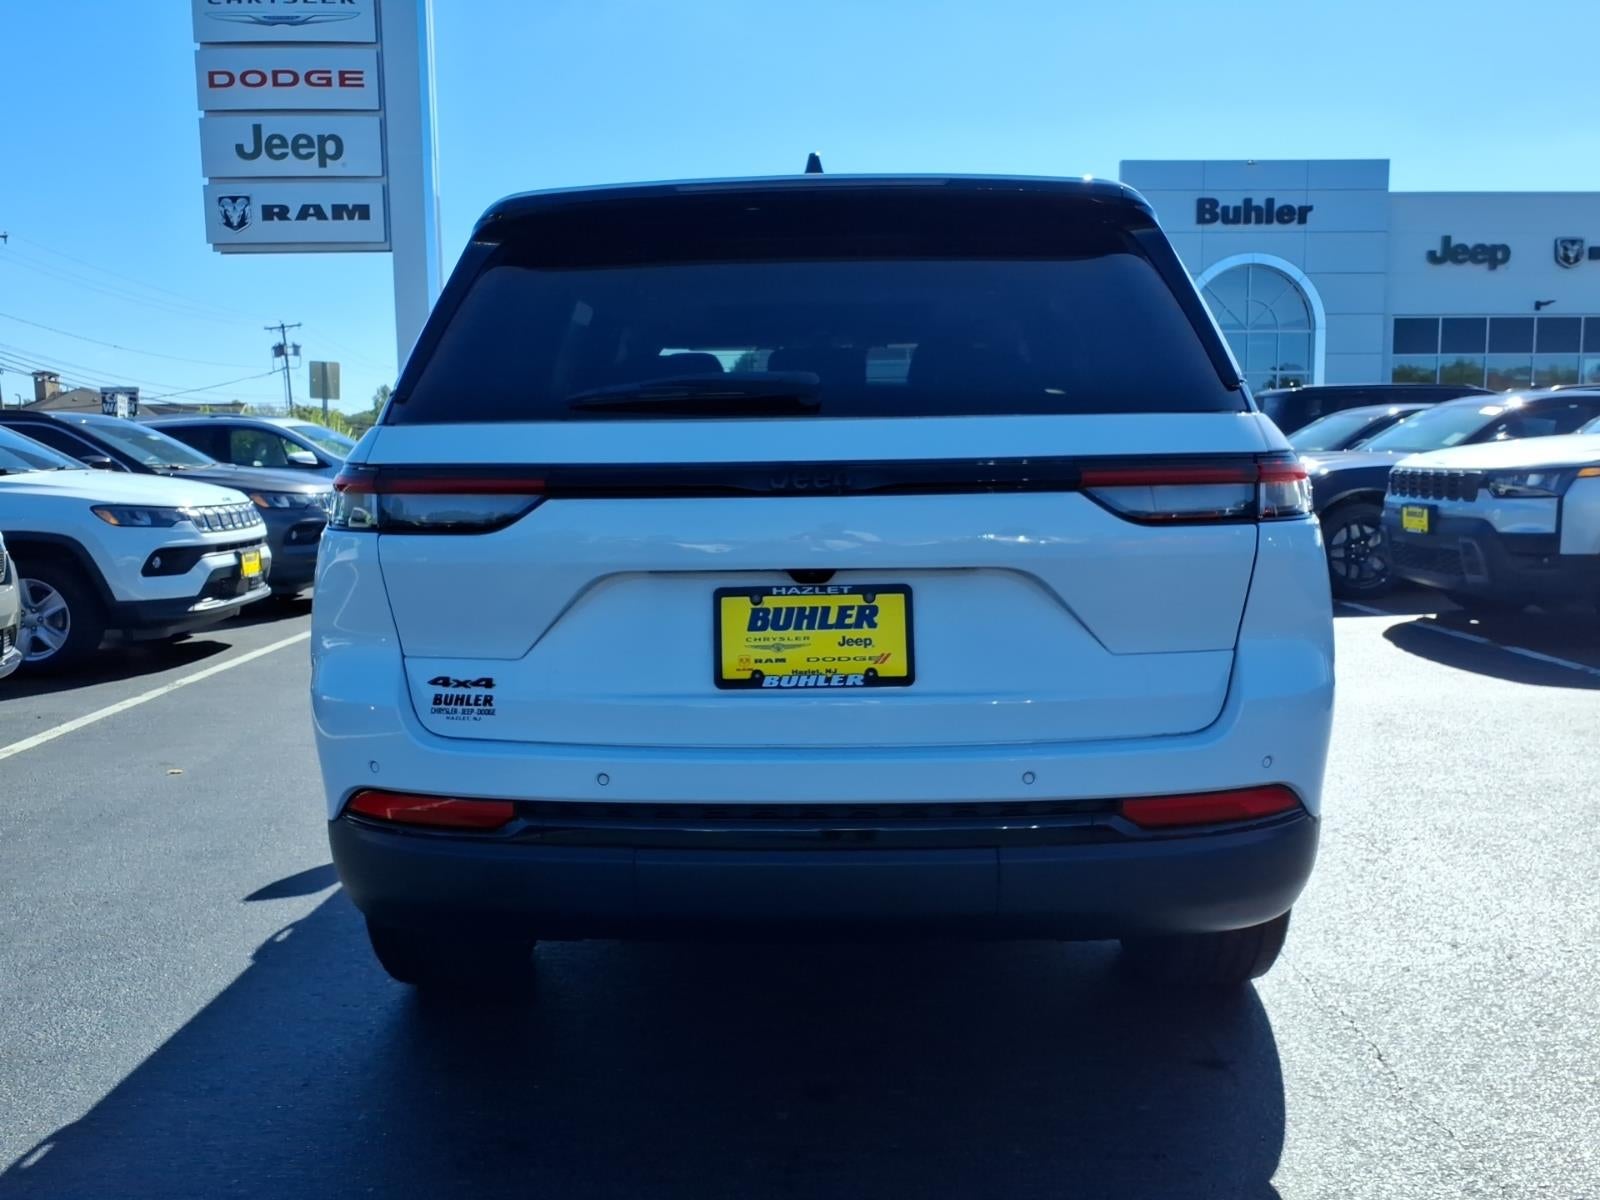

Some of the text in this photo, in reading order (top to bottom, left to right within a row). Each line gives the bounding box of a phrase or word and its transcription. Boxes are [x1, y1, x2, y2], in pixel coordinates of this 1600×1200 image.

[208, 70, 365, 88] DODGE
[235, 124, 344, 168] Jeep
[261, 204, 371, 221] RAM
[1196, 198, 1314, 226] Buhler
[1426, 235, 1512, 271] Jeep
[772, 586, 852, 595] HAZLET
[747, 604, 879, 632] BUHLER
[838, 636, 873, 648] Jeep
[427, 676, 496, 688] 4x4
[762, 675, 864, 687] BUHLER
[432, 693, 494, 707] BUHLER
